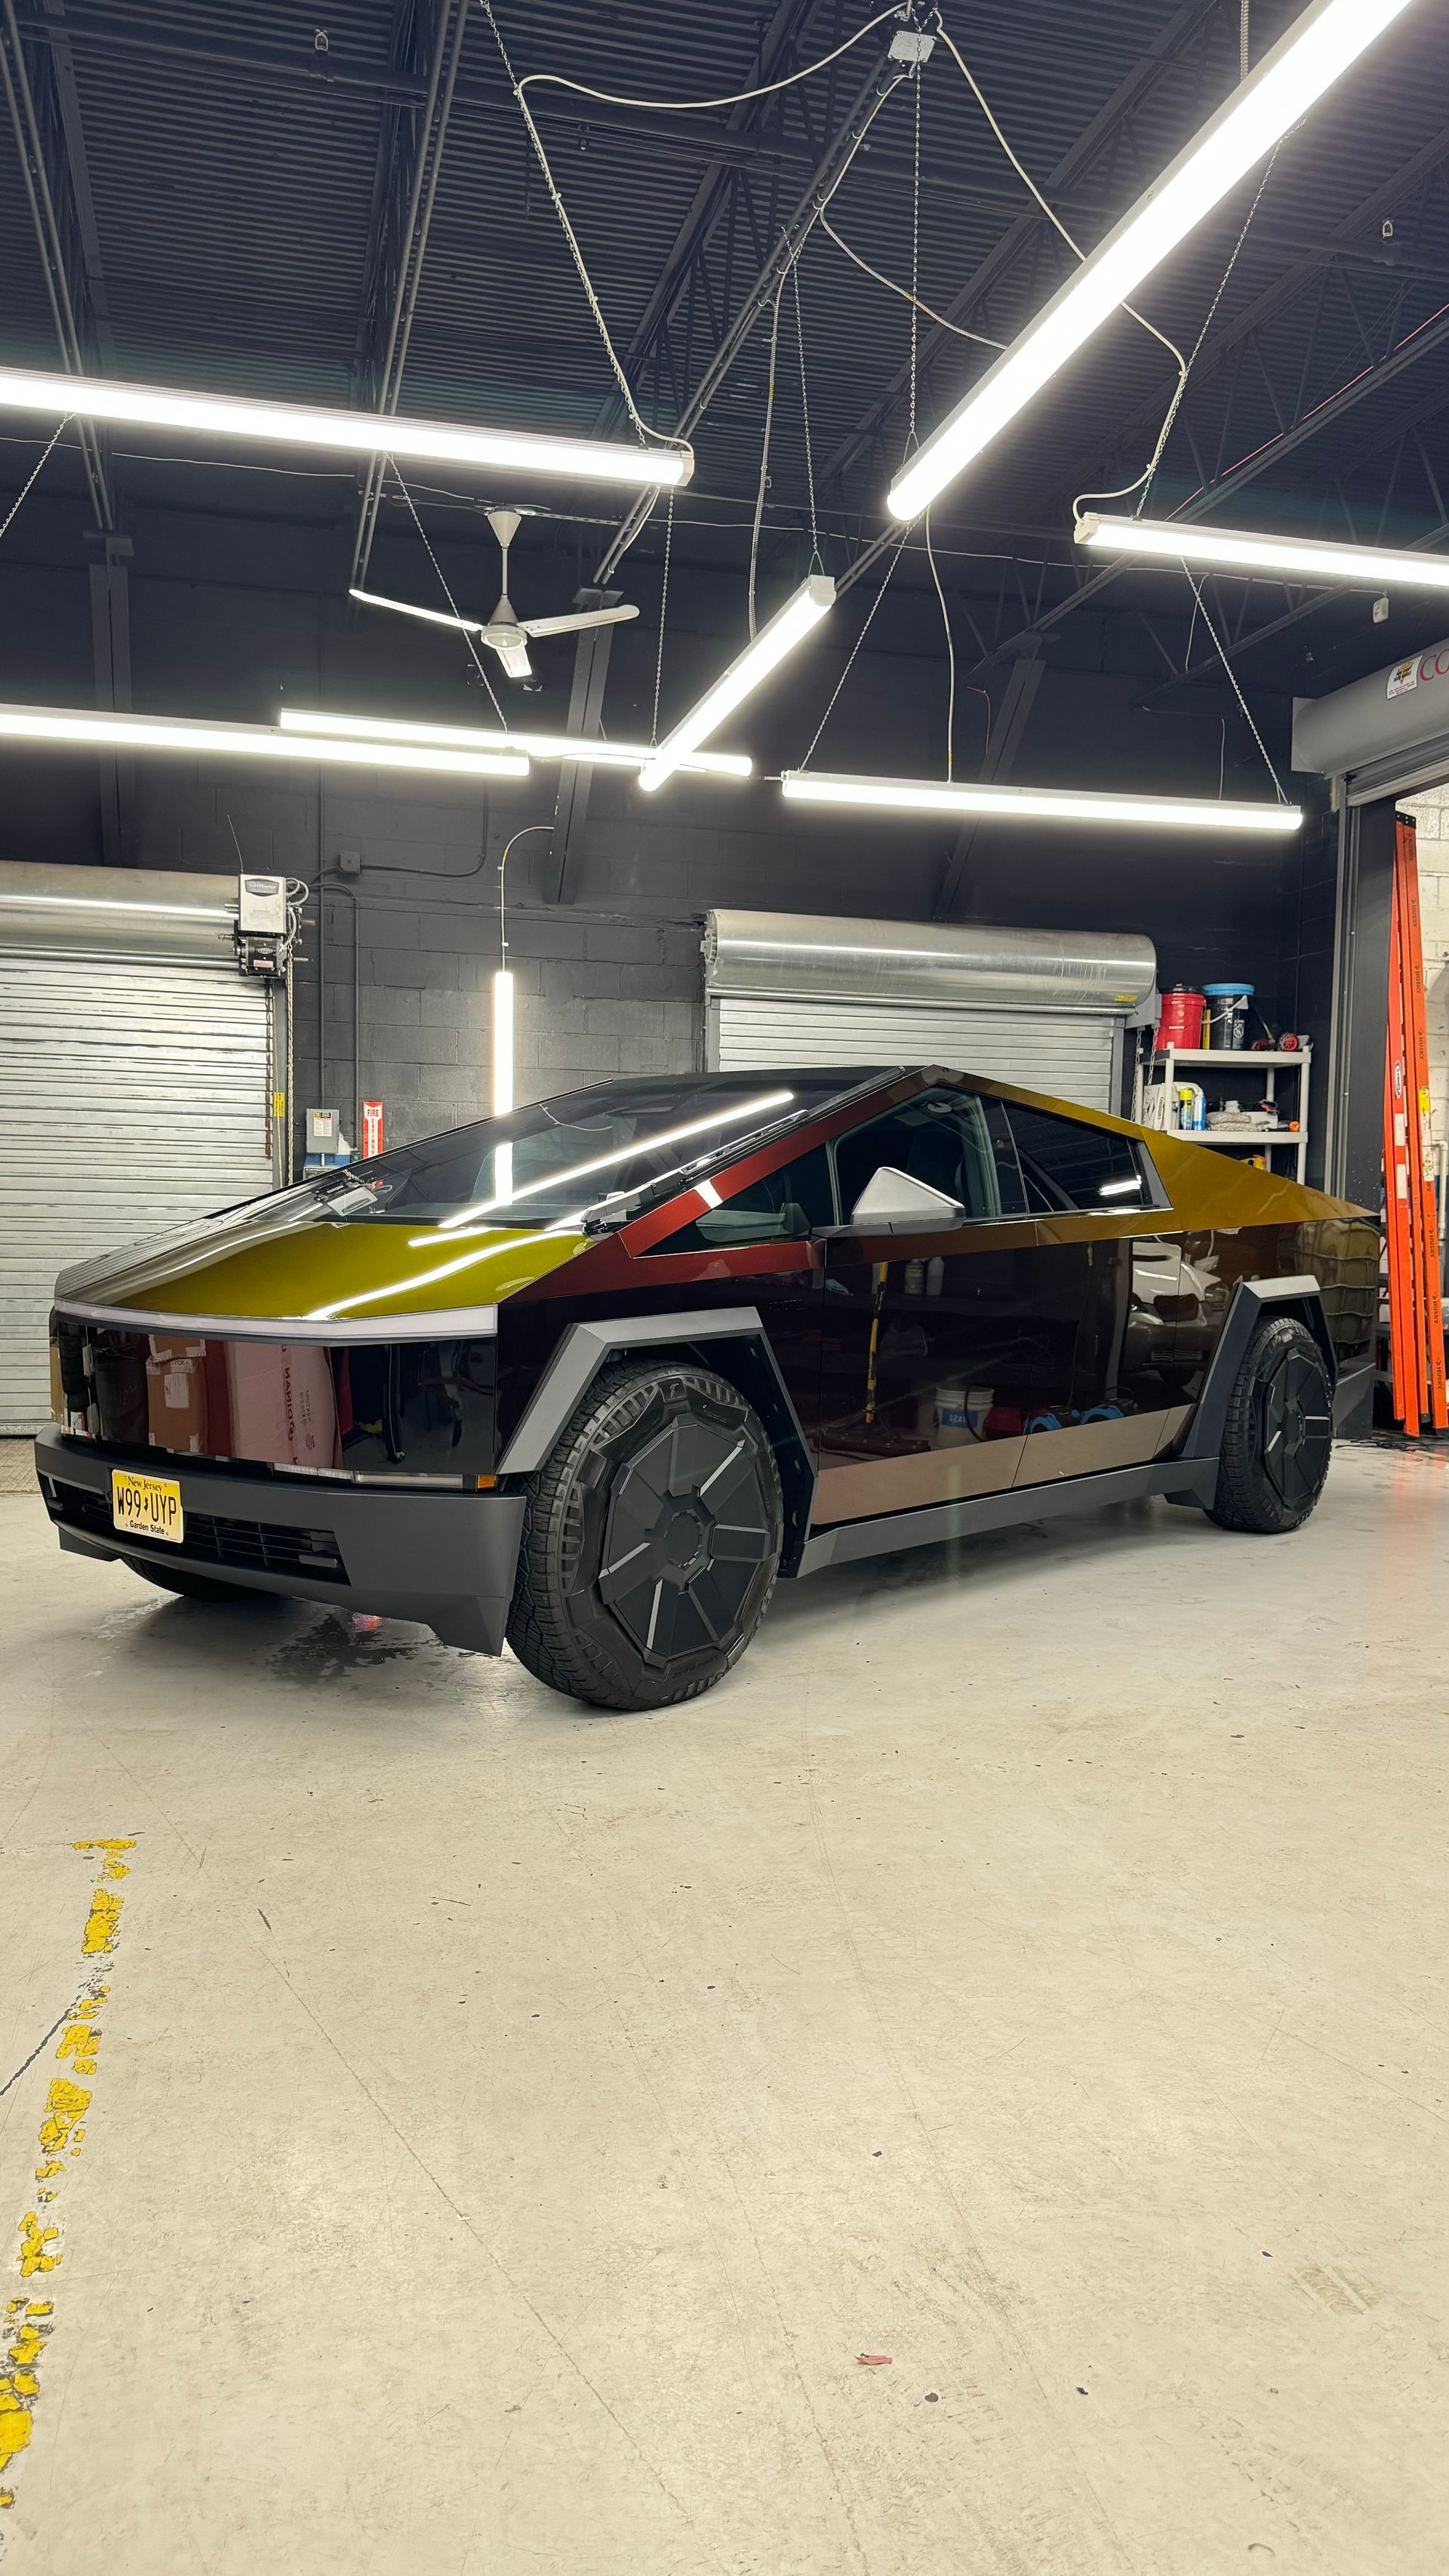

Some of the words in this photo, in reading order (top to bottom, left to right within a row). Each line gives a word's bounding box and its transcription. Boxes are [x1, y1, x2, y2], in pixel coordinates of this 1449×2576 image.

[367, 1109, 379, 1117] FIRE
[128, 1476, 142, 1487] New
[143, 1479, 163, 1493] Jersey
[130, 1520, 149, 1531] Garden
[150, 1525, 165, 1534] State
